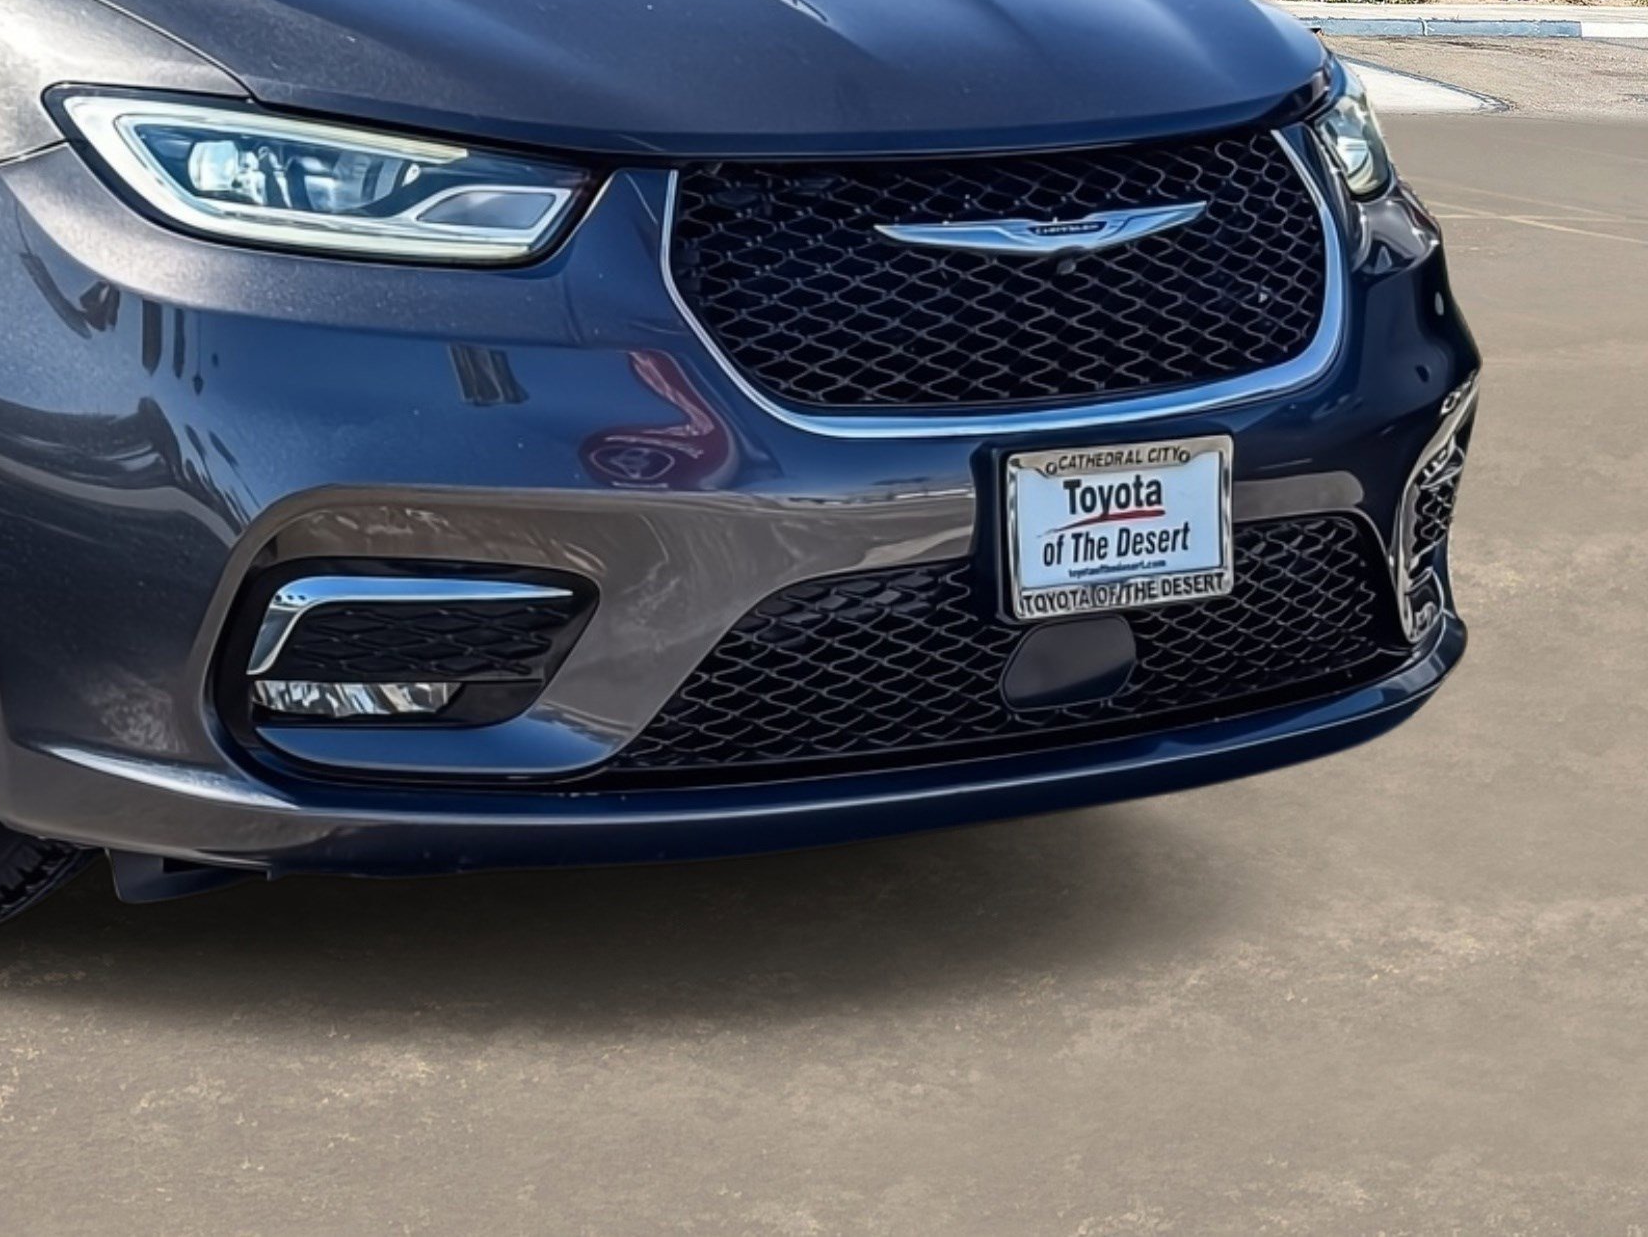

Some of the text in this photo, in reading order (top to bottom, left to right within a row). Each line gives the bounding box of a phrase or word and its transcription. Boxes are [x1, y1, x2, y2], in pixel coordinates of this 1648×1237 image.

[1058, 446, 1181, 471] CATHEDRAL CITY
[1063, 474, 1163, 517] Toyota
[1043, 521, 1191, 567] of The Desert
[1024, 588, 1090, 612] TOYOTA
[1121, 579, 1159, 601] THE
[1161, 572, 1226, 597] DESERT
